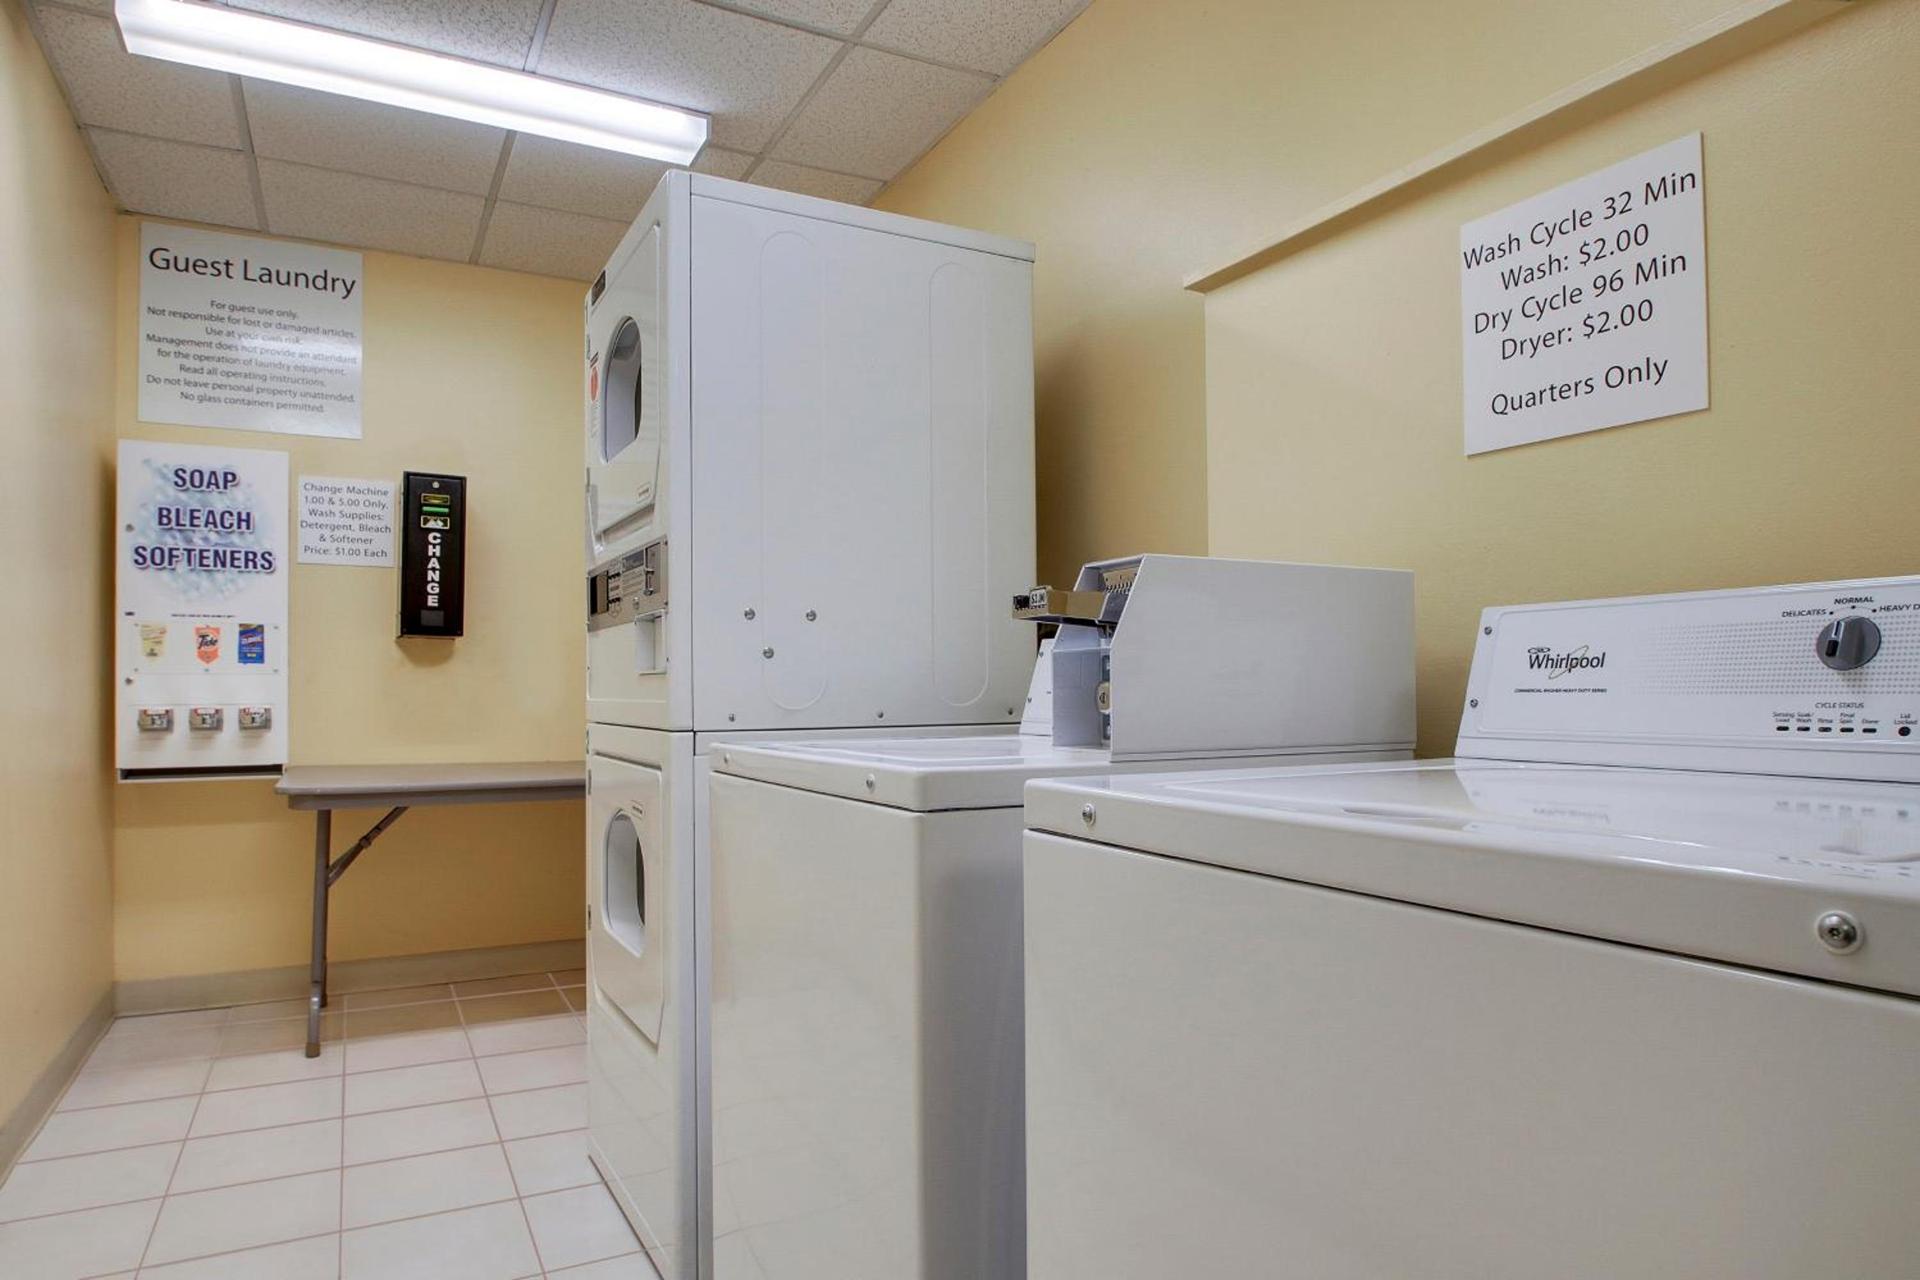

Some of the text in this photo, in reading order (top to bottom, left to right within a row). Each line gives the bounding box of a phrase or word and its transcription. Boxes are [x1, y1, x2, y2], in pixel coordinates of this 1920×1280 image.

[1463, 172, 1695, 269] Wash Cycle 32 Min
[1501, 223, 1649, 290] Wash: $2.00
[149, 247, 356, 298] Guest Laundry
[1474, 255, 1686, 333] Dry Cycle 96 Min
[211, 300, 297, 319] For guest use only.
[147, 307, 356, 338] Not responsible for lost or damaged articles.
[1502, 299, 1653, 359] Dryer: $2.00
[206, 328, 223, 336] Use
[226, 330, 234, 338] at
[236, 332, 259, 342] your
[147, 334, 213, 350] Management
[215, 340, 239, 352] does
[241, 344, 257, 353] not
[260, 345, 296, 359] provide
[158, 349, 171, 357] for
[174, 350, 190, 360] the
[193, 353, 241, 366] operation
[243, 358, 253, 367] of
[255, 359, 291, 372] laundry
[180, 364, 325, 387] Read all operating instructions.
[1491, 357, 1668, 415] Quarters Only
[147, 375, 354, 403] Do not leave personal property unattended.
[181, 392, 195, 401] No
[197, 393, 222, 404] glass
[224, 397, 274, 409] containers
[174, 468, 238, 490] SOAP
[304, 483, 389, 496] Change Machine
[305, 496, 324, 505] 1.00
[328, 497, 335, 505] &
[338, 497, 359, 507] 5.00
[158, 507, 252, 531] BLEACH
[308, 508, 384, 522] Wash Supplies:
[300, 521, 391, 533] Detergent, Bleach
[319, 534, 373, 545] & Softener
[134, 545, 274, 571] SOFTENERS
[304, 546, 387, 558] Price: $1.00 Each
[427, 532, 441, 606] CHANGE
[1834, 596, 1874, 604] NORMAL
[1879, 604, 1911, 612] HEAVY
[1782, 609, 1826, 617] DELICATES
[198, 635, 217, 649] Tide
[1529, 652, 1605, 673] Whirlpool
